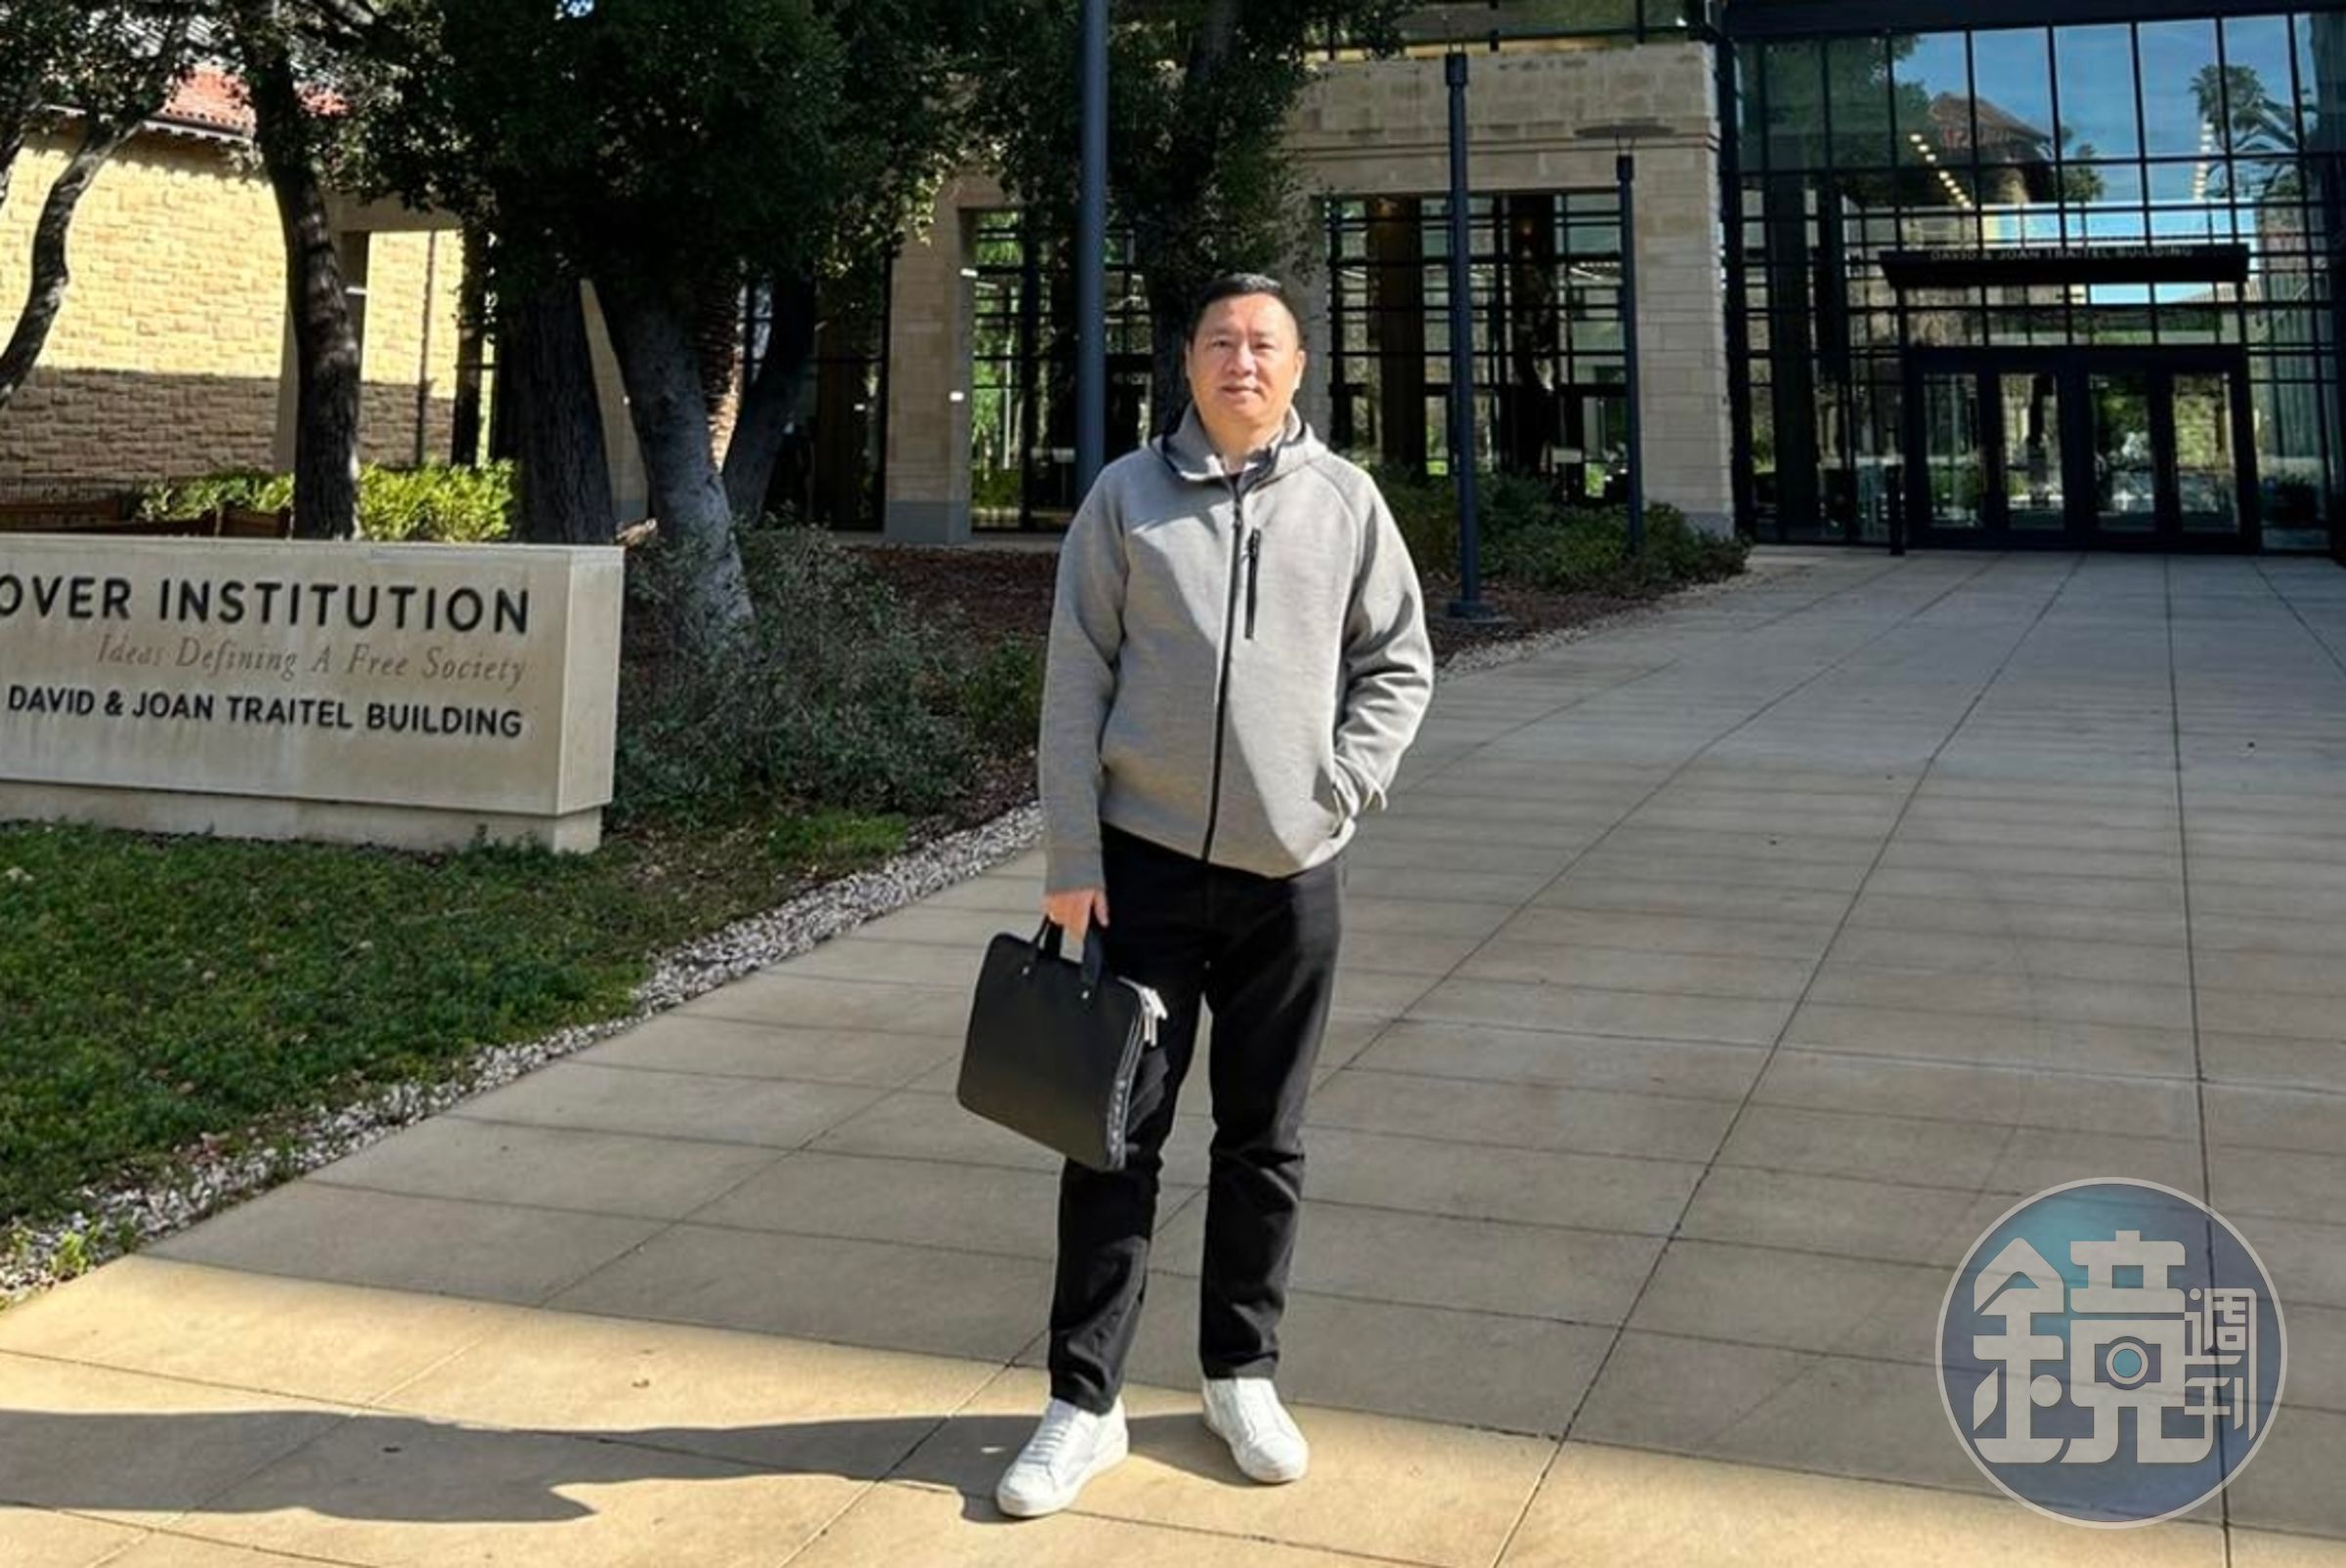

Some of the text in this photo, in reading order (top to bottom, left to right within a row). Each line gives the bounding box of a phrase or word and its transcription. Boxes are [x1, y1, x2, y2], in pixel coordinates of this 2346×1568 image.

[0, 573, 529, 634] OVER INSTITUTION
[97, 633, 527, 693] Ideas Defining A Free Society
[8, 683, 524, 739] DAVID & JOAN TRAITEL BUILDING
